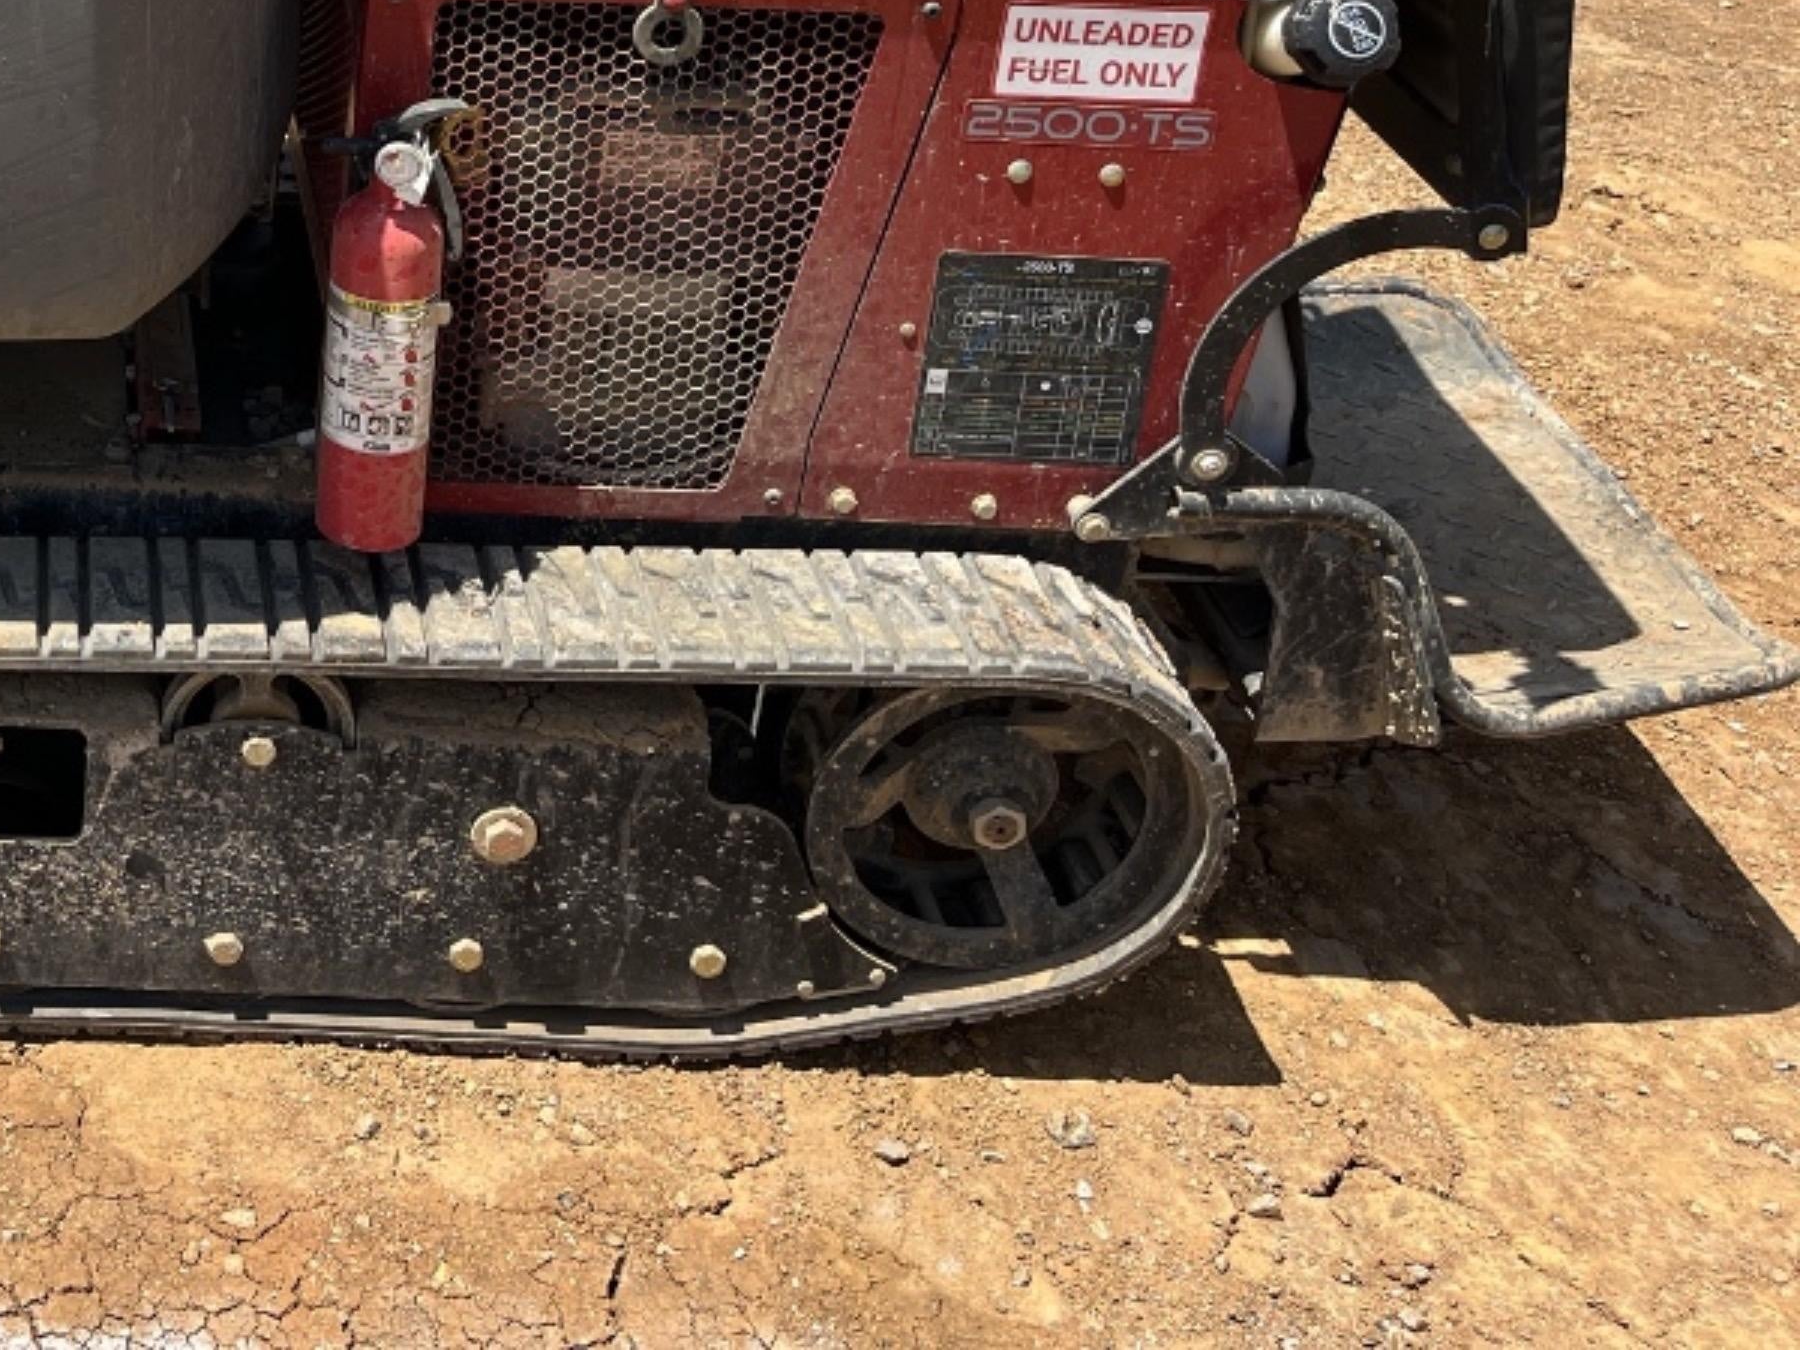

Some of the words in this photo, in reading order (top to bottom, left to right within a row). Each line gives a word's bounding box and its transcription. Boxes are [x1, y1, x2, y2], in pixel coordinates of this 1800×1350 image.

[1015, 18, 1195, 49] UNLEADED
[1007, 59, 1088, 84] FUEL
[1100, 61, 1187, 87] ONLY
